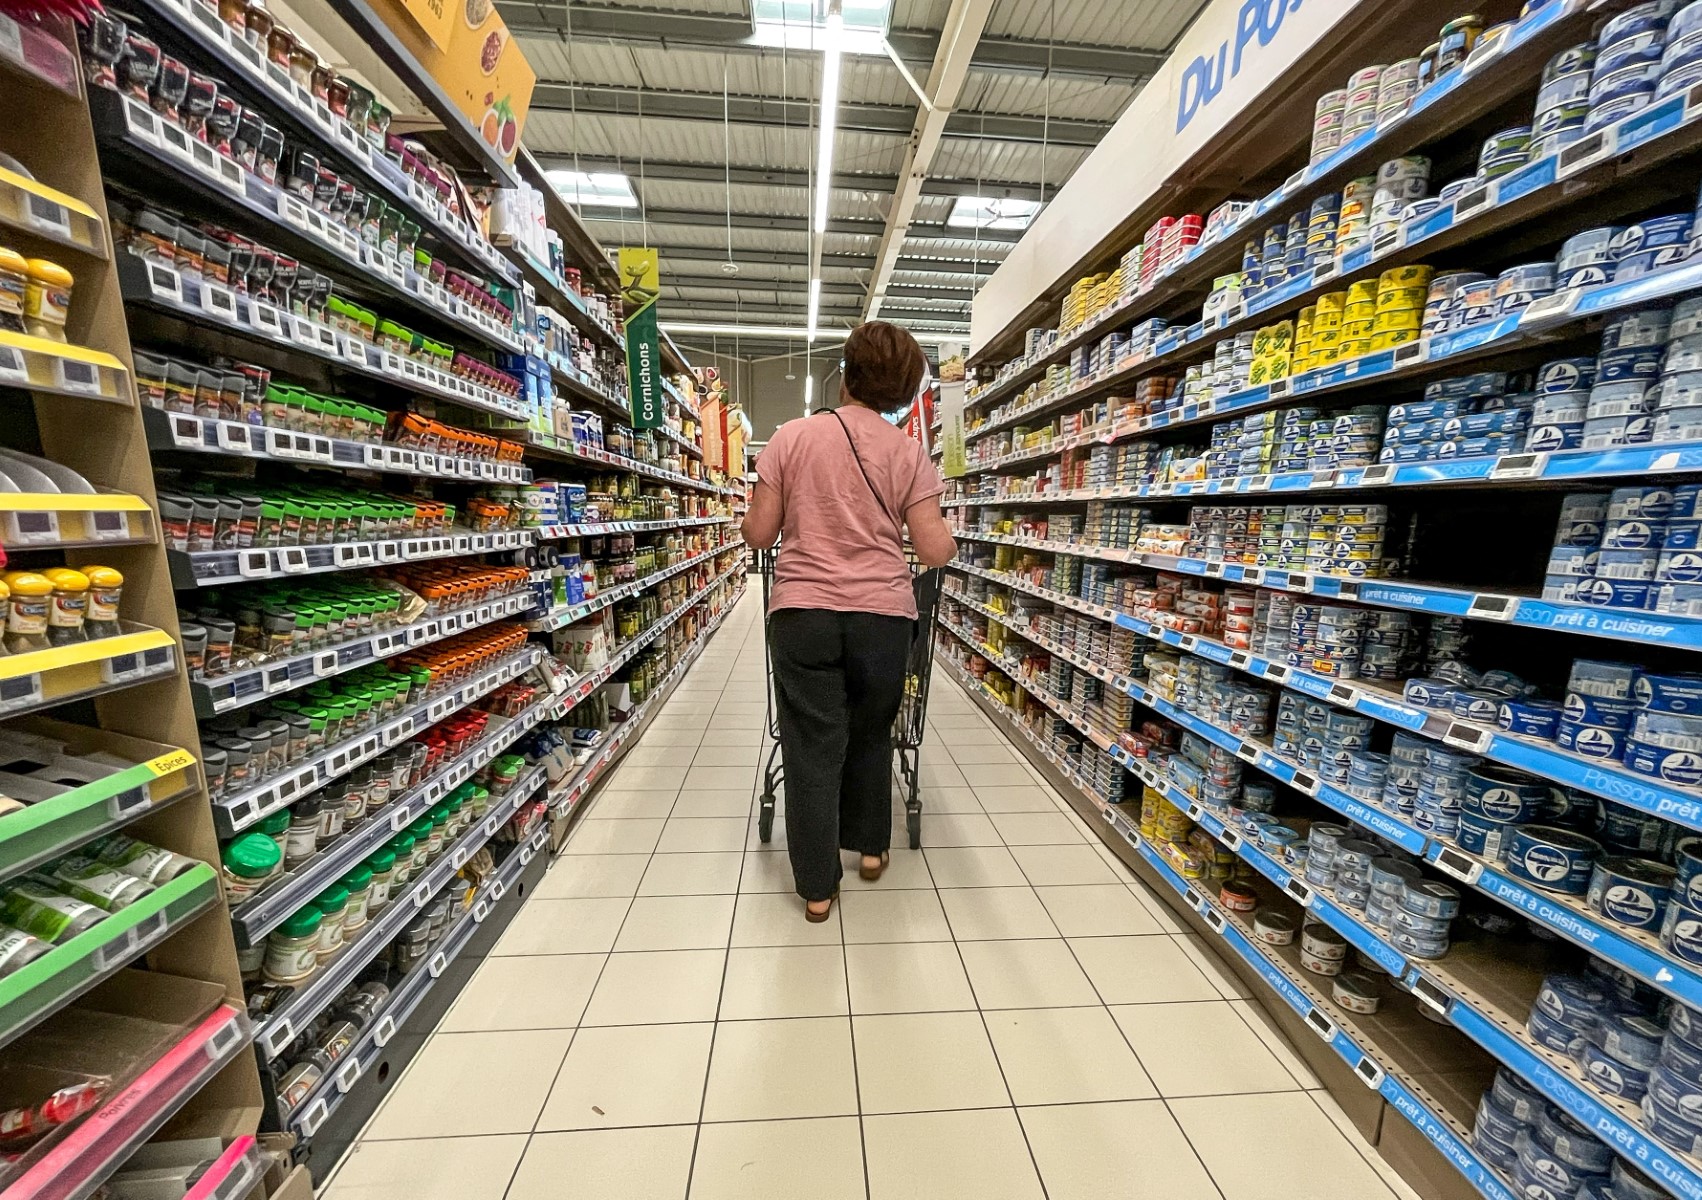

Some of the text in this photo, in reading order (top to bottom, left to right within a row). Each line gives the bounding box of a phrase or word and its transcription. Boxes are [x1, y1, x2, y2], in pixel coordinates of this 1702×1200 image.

[1176, 0, 1303, 135] Du Po
[639, 342, 654, 421] Cornichons
[912, 416, 920, 440] oupes
[1390, 592, 1427, 606] cuisiner
[1551, 611, 1583, 627] prêt
[1586, 613, 1600, 629] à
[1601, 618, 1675, 637] cuisiner
[155, 757, 187, 773] Épices
[1320, 787, 1408, 840] oisson prêt à cuisiner
[1583, 768, 1657, 807] Poisson
[1656, 798, 1701, 821] prêt
[1497, 883, 1600, 943] prêt à cuisiner
[1268, 971, 1282, 988] prêt
[1395, 1096, 1473, 1169] prêt à cuisiner
[1534, 1065, 1598, 1122] Poisson
[1597, 1118, 1637, 1150] prêt
[1635, 1143, 1650, 1162] à
